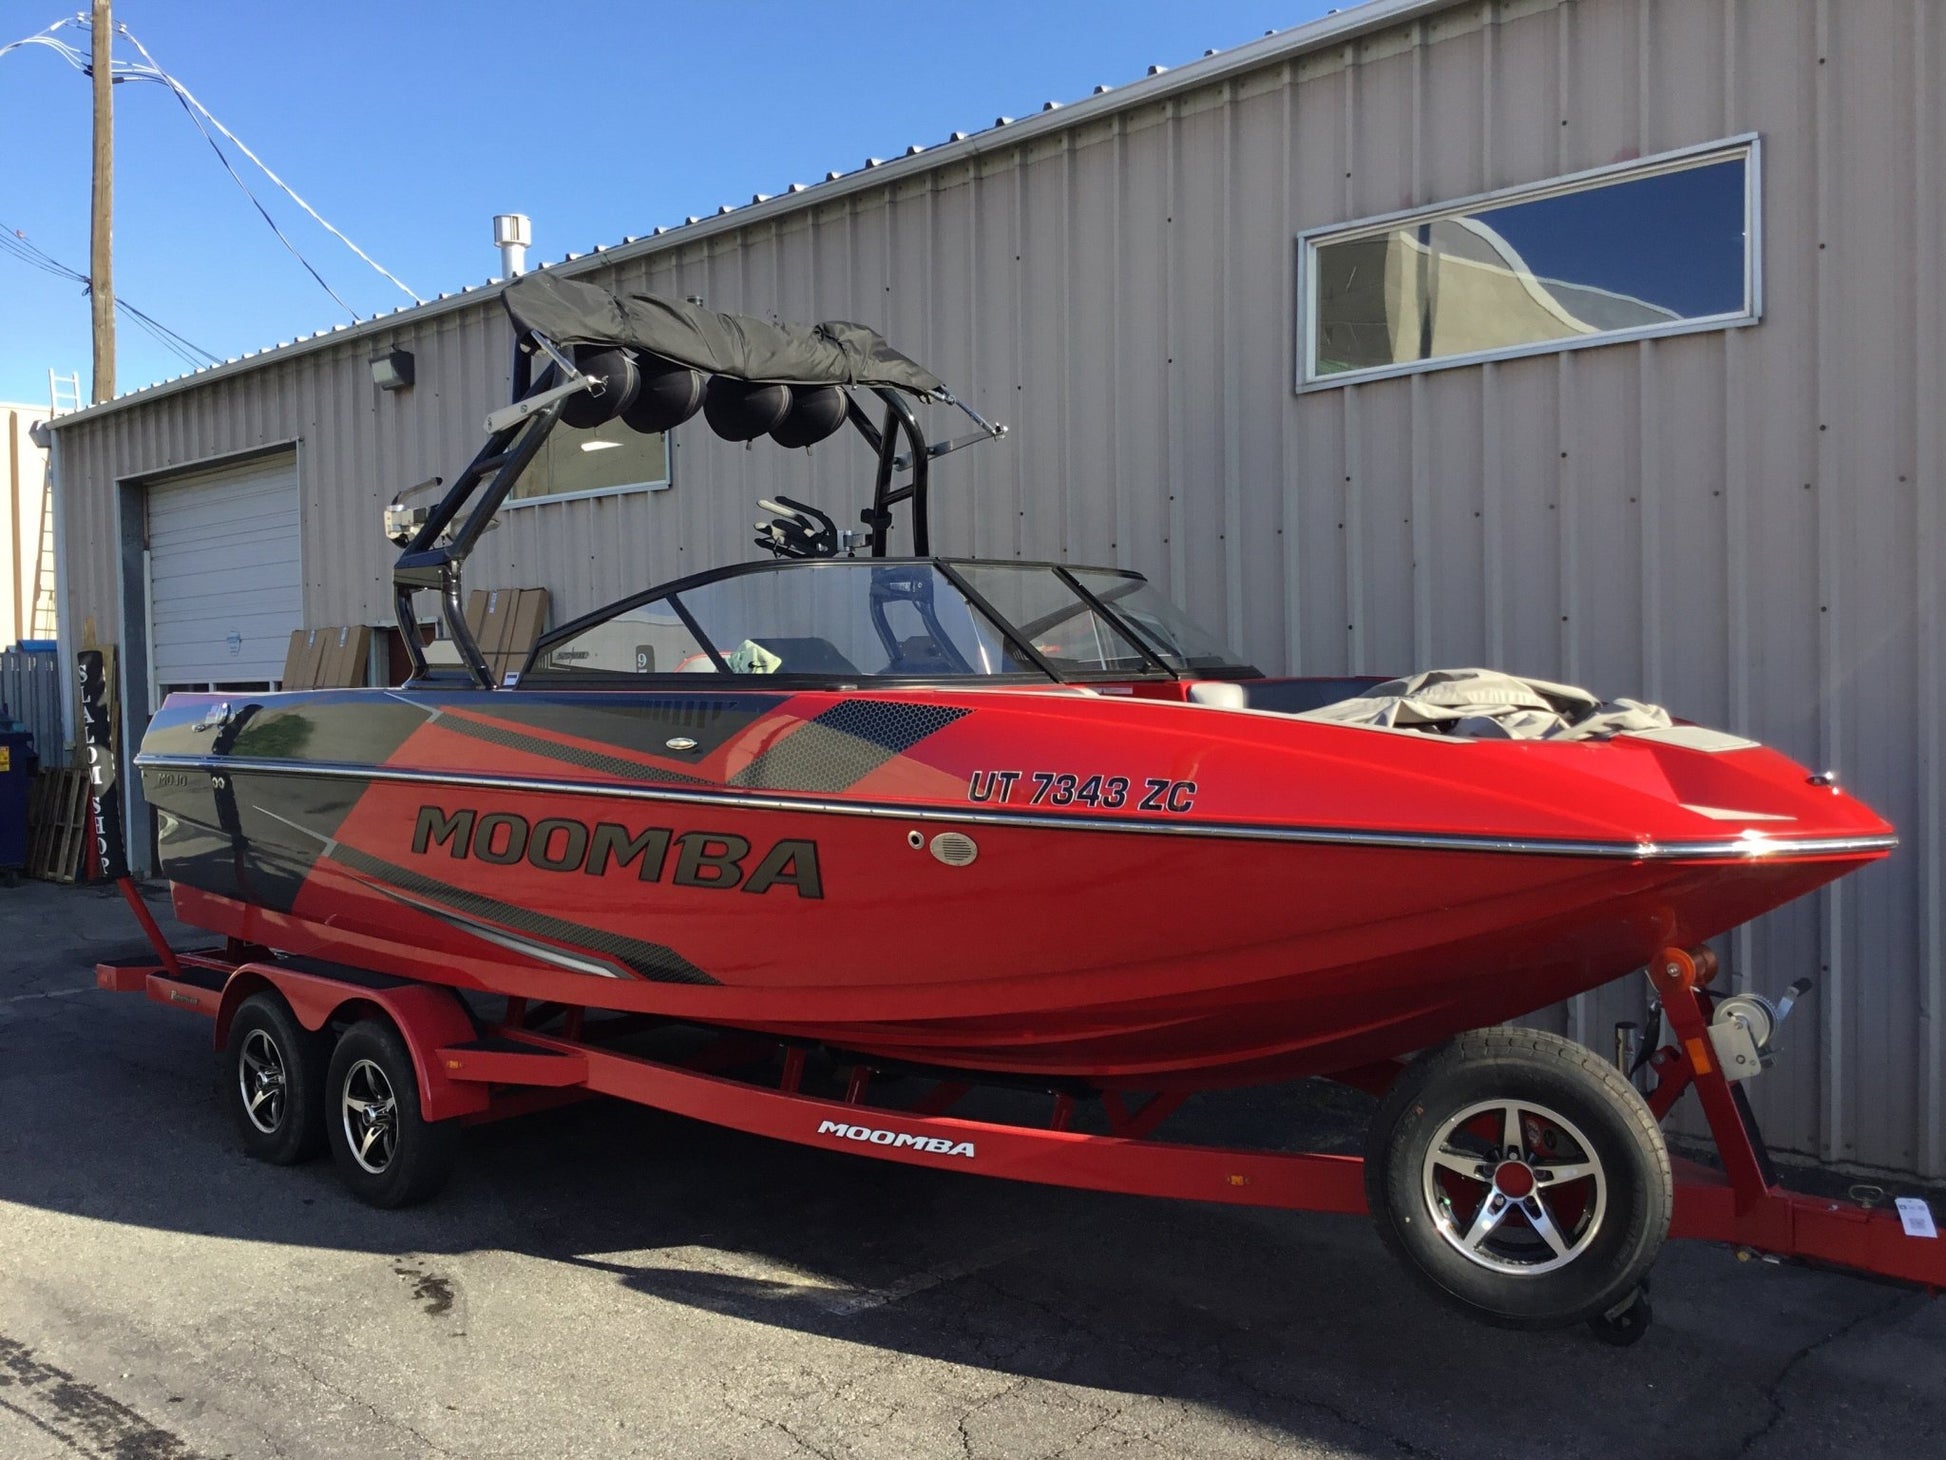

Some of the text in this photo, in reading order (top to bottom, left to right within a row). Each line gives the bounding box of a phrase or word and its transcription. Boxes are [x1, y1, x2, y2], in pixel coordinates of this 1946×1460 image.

[78, 664, 110, 875] SLALOM SHOP
[968, 770, 1198, 814] UT 7343 ZC
[411, 805, 825, 900] MOOMBA
[817, 1120, 976, 1158] MOOMBA
